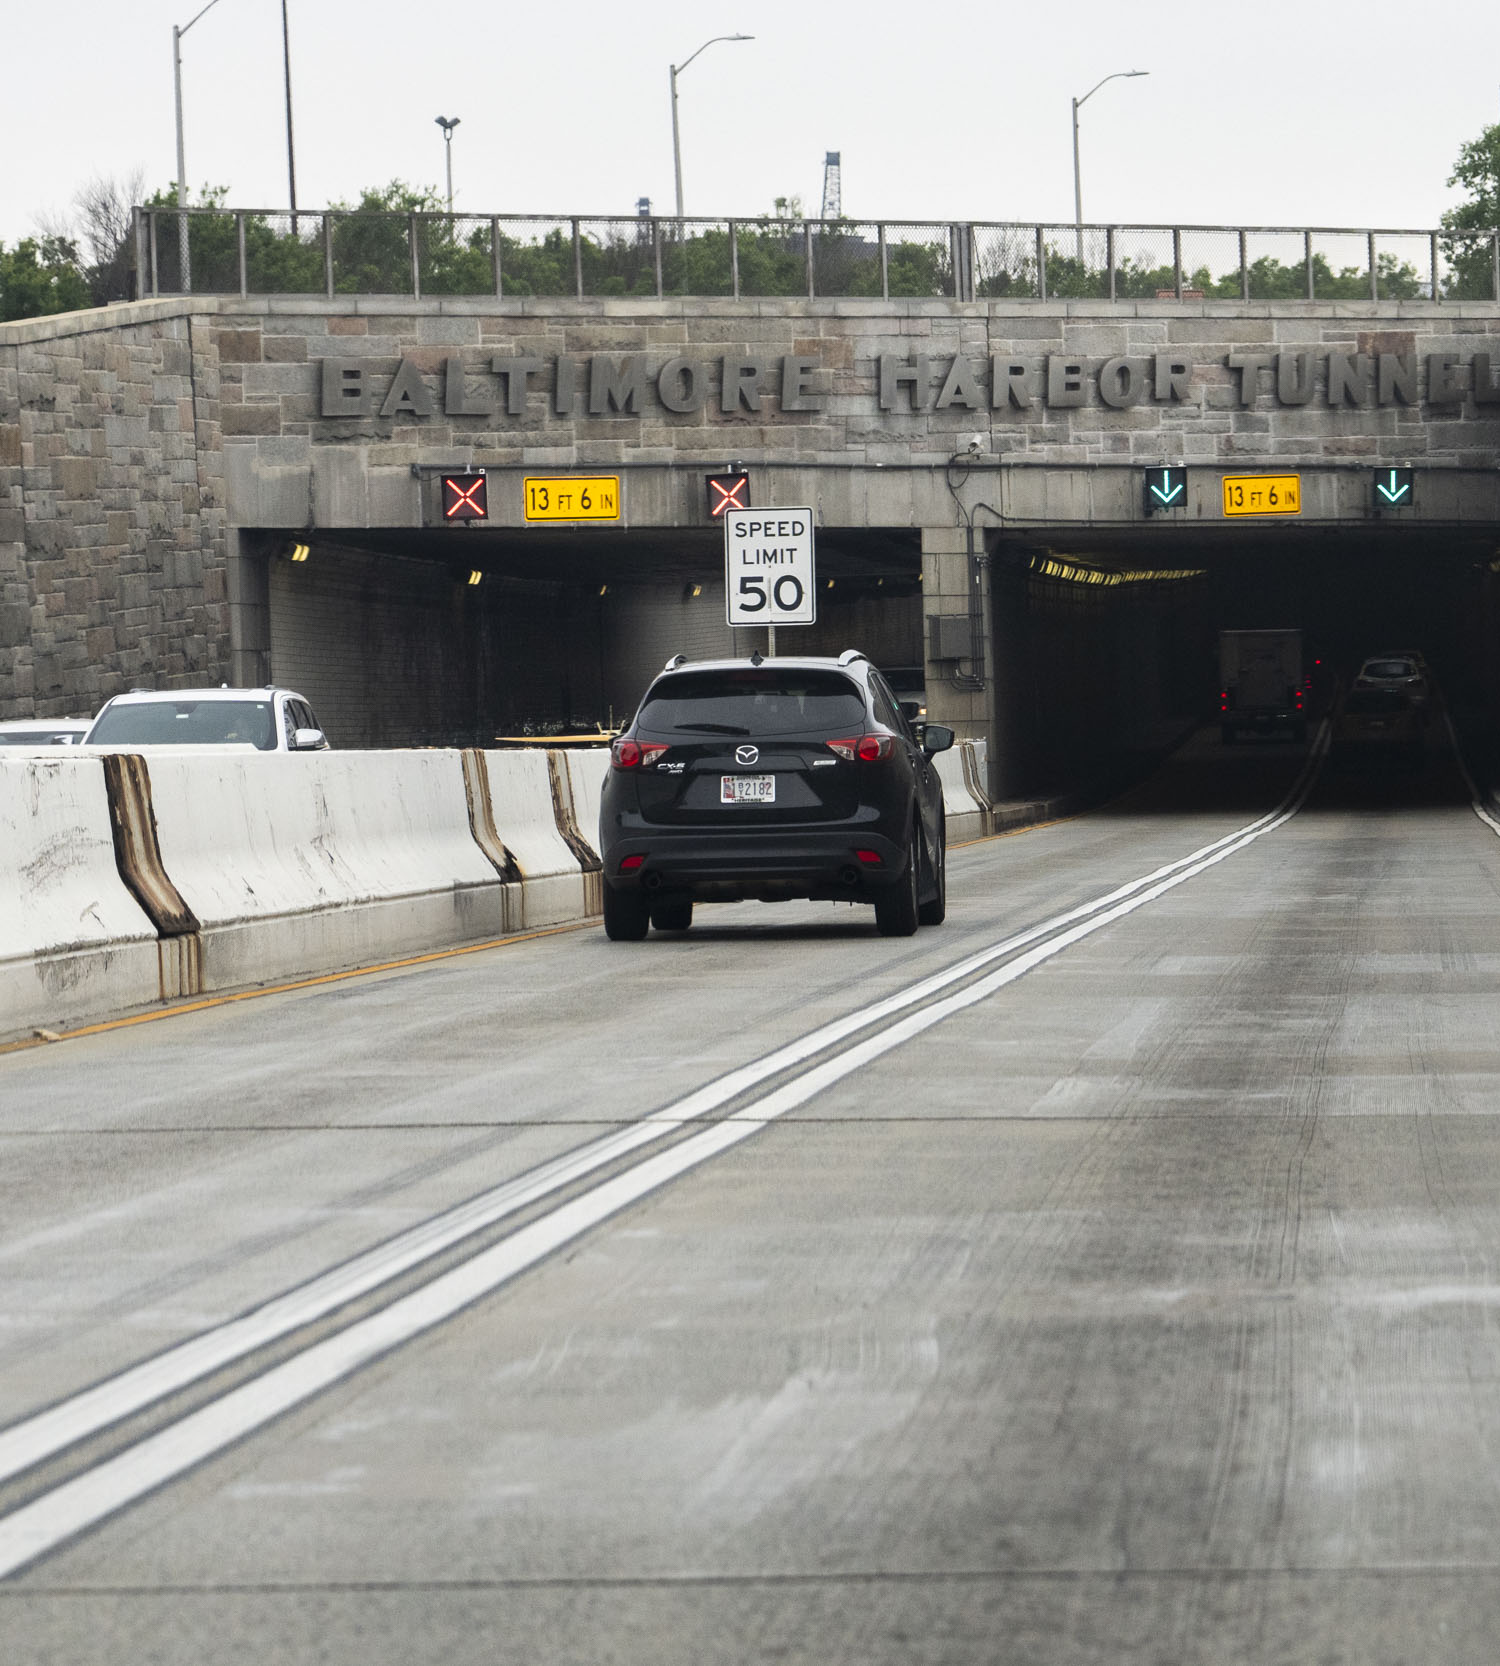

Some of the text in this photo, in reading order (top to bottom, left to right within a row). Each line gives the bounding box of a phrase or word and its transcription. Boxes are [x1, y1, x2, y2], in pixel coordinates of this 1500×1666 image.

[320, 354, 824, 417] BALTIMORE
[878, 352, 1194, 410] HARBOR
[530, 487, 613, 511] 13 FT 6 IN
[1228, 485, 1295, 507] 13 FT 6 IN
[735, 521, 804, 537] SPEED
[742, 548, 797, 564] LIMIT
[738, 574, 804, 612] 50
